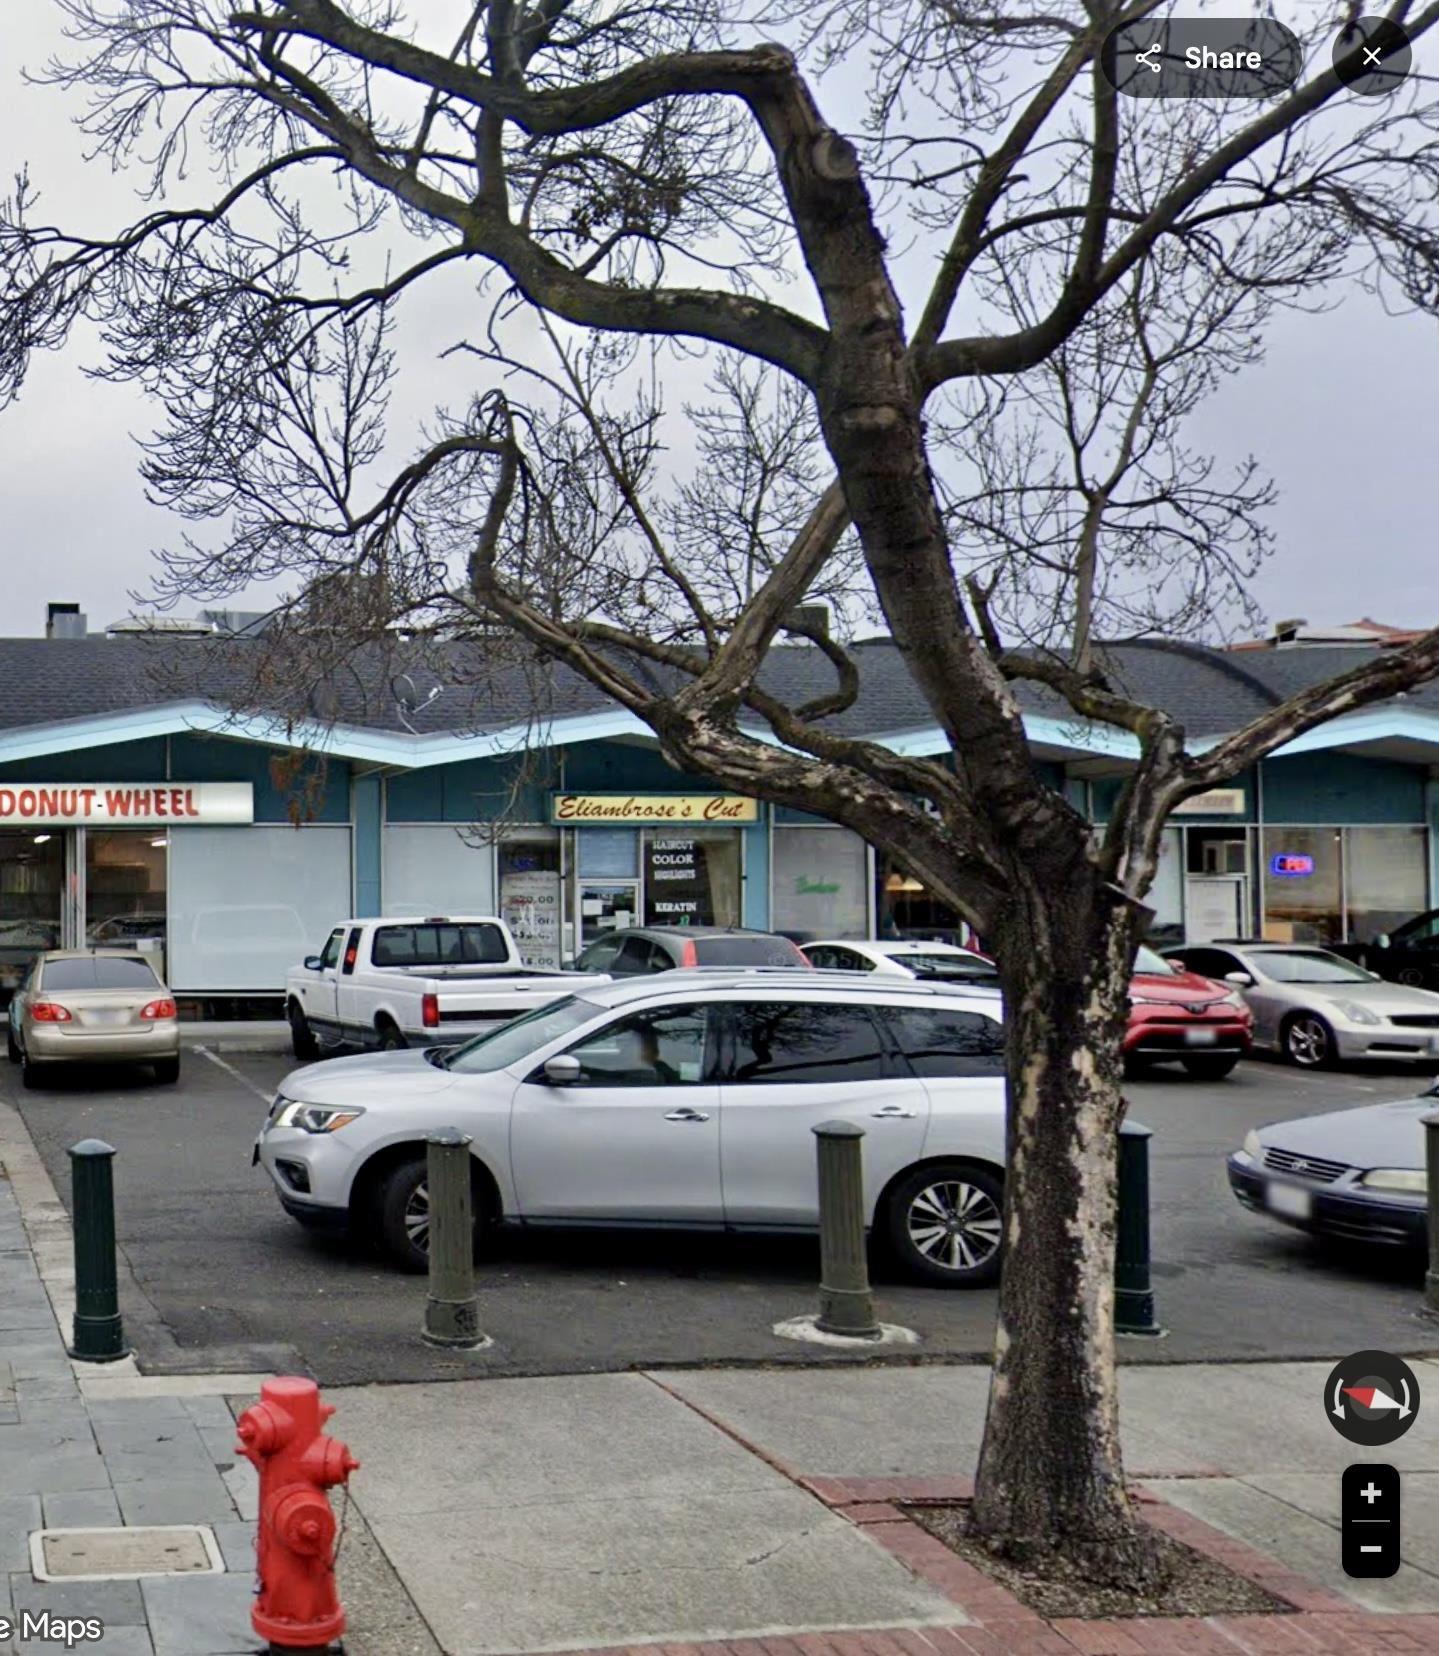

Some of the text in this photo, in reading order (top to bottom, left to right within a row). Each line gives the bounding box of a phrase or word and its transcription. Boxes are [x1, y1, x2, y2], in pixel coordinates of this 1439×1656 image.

[558, 796, 744, 820] Eliambrose's Cut
[652, 855, 694, 864] COLOR
[655, 902, 697, 912] KERATIN
